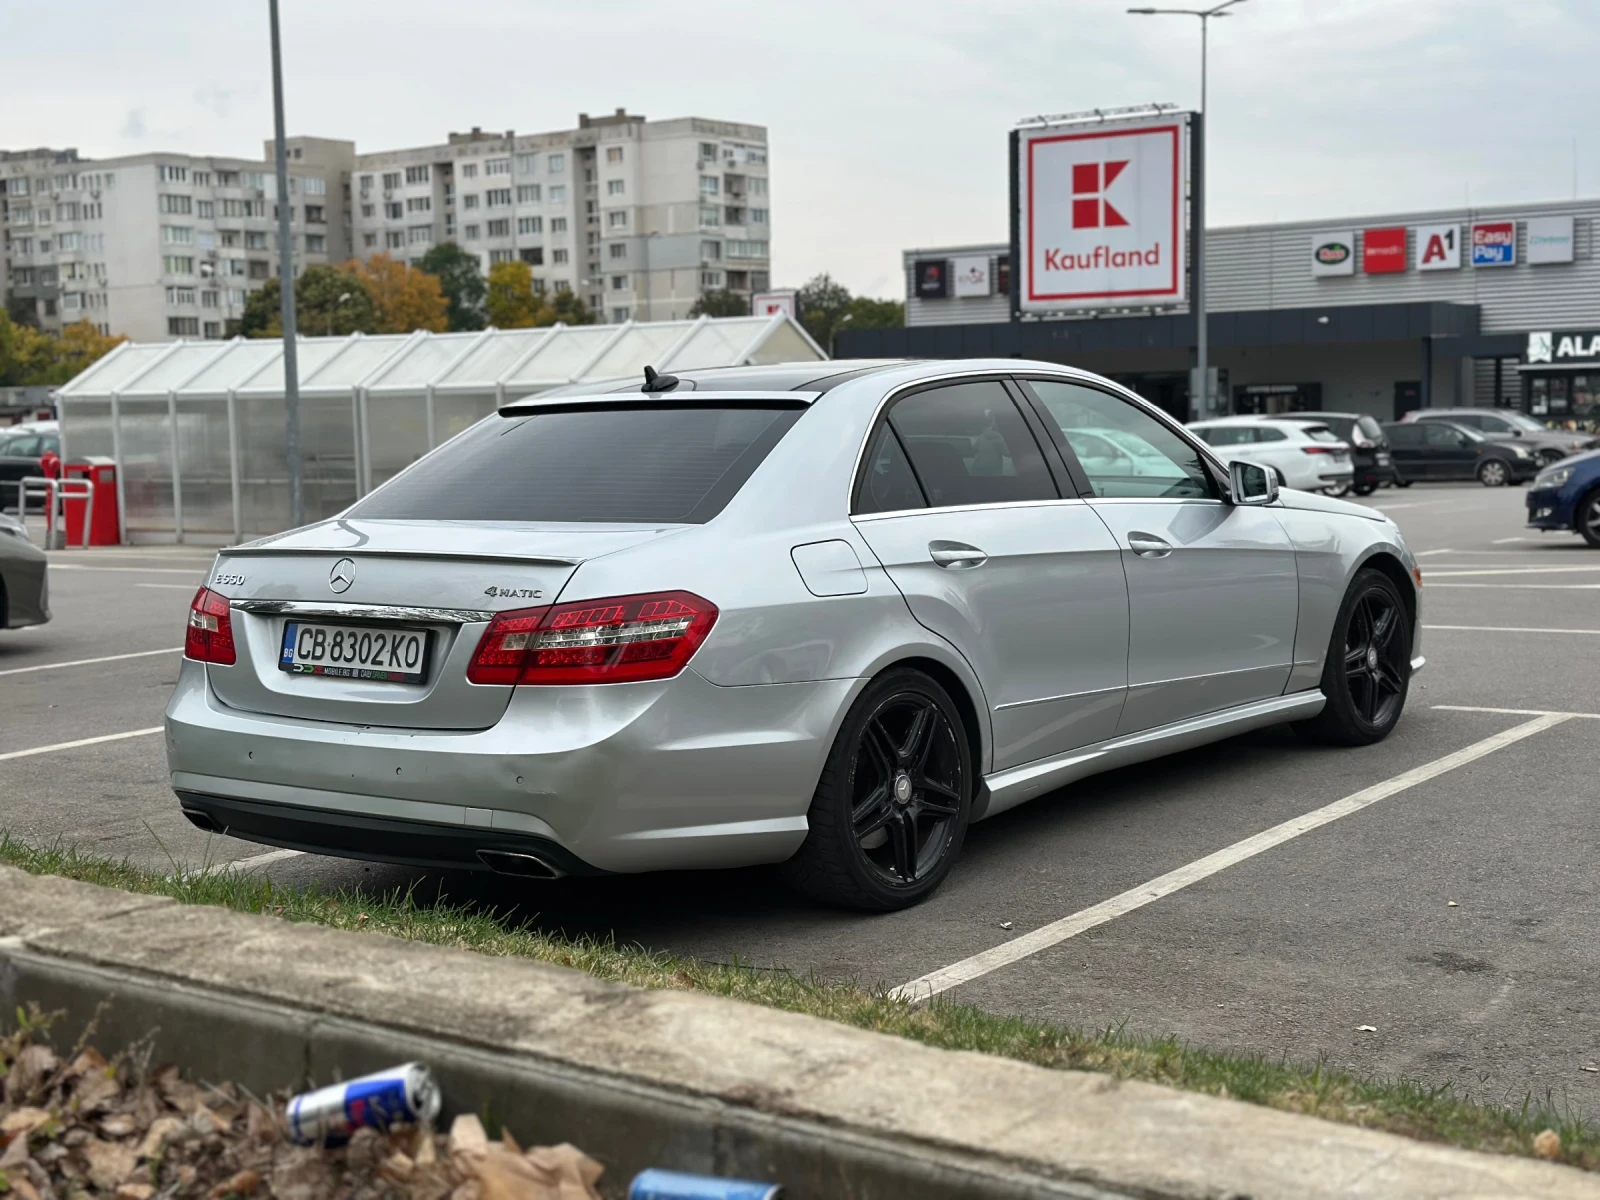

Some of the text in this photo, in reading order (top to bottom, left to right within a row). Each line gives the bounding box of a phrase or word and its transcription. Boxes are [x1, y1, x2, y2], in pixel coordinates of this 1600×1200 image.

[1474, 230, 1512, 246] Easy
[1421, 229, 1455, 264] A1
[1474, 245, 1504, 262] Pay
[1044, 242, 1160, 271] Kaufland
[214, 574, 246, 586] E550
[283, 647, 294, 658] BG
